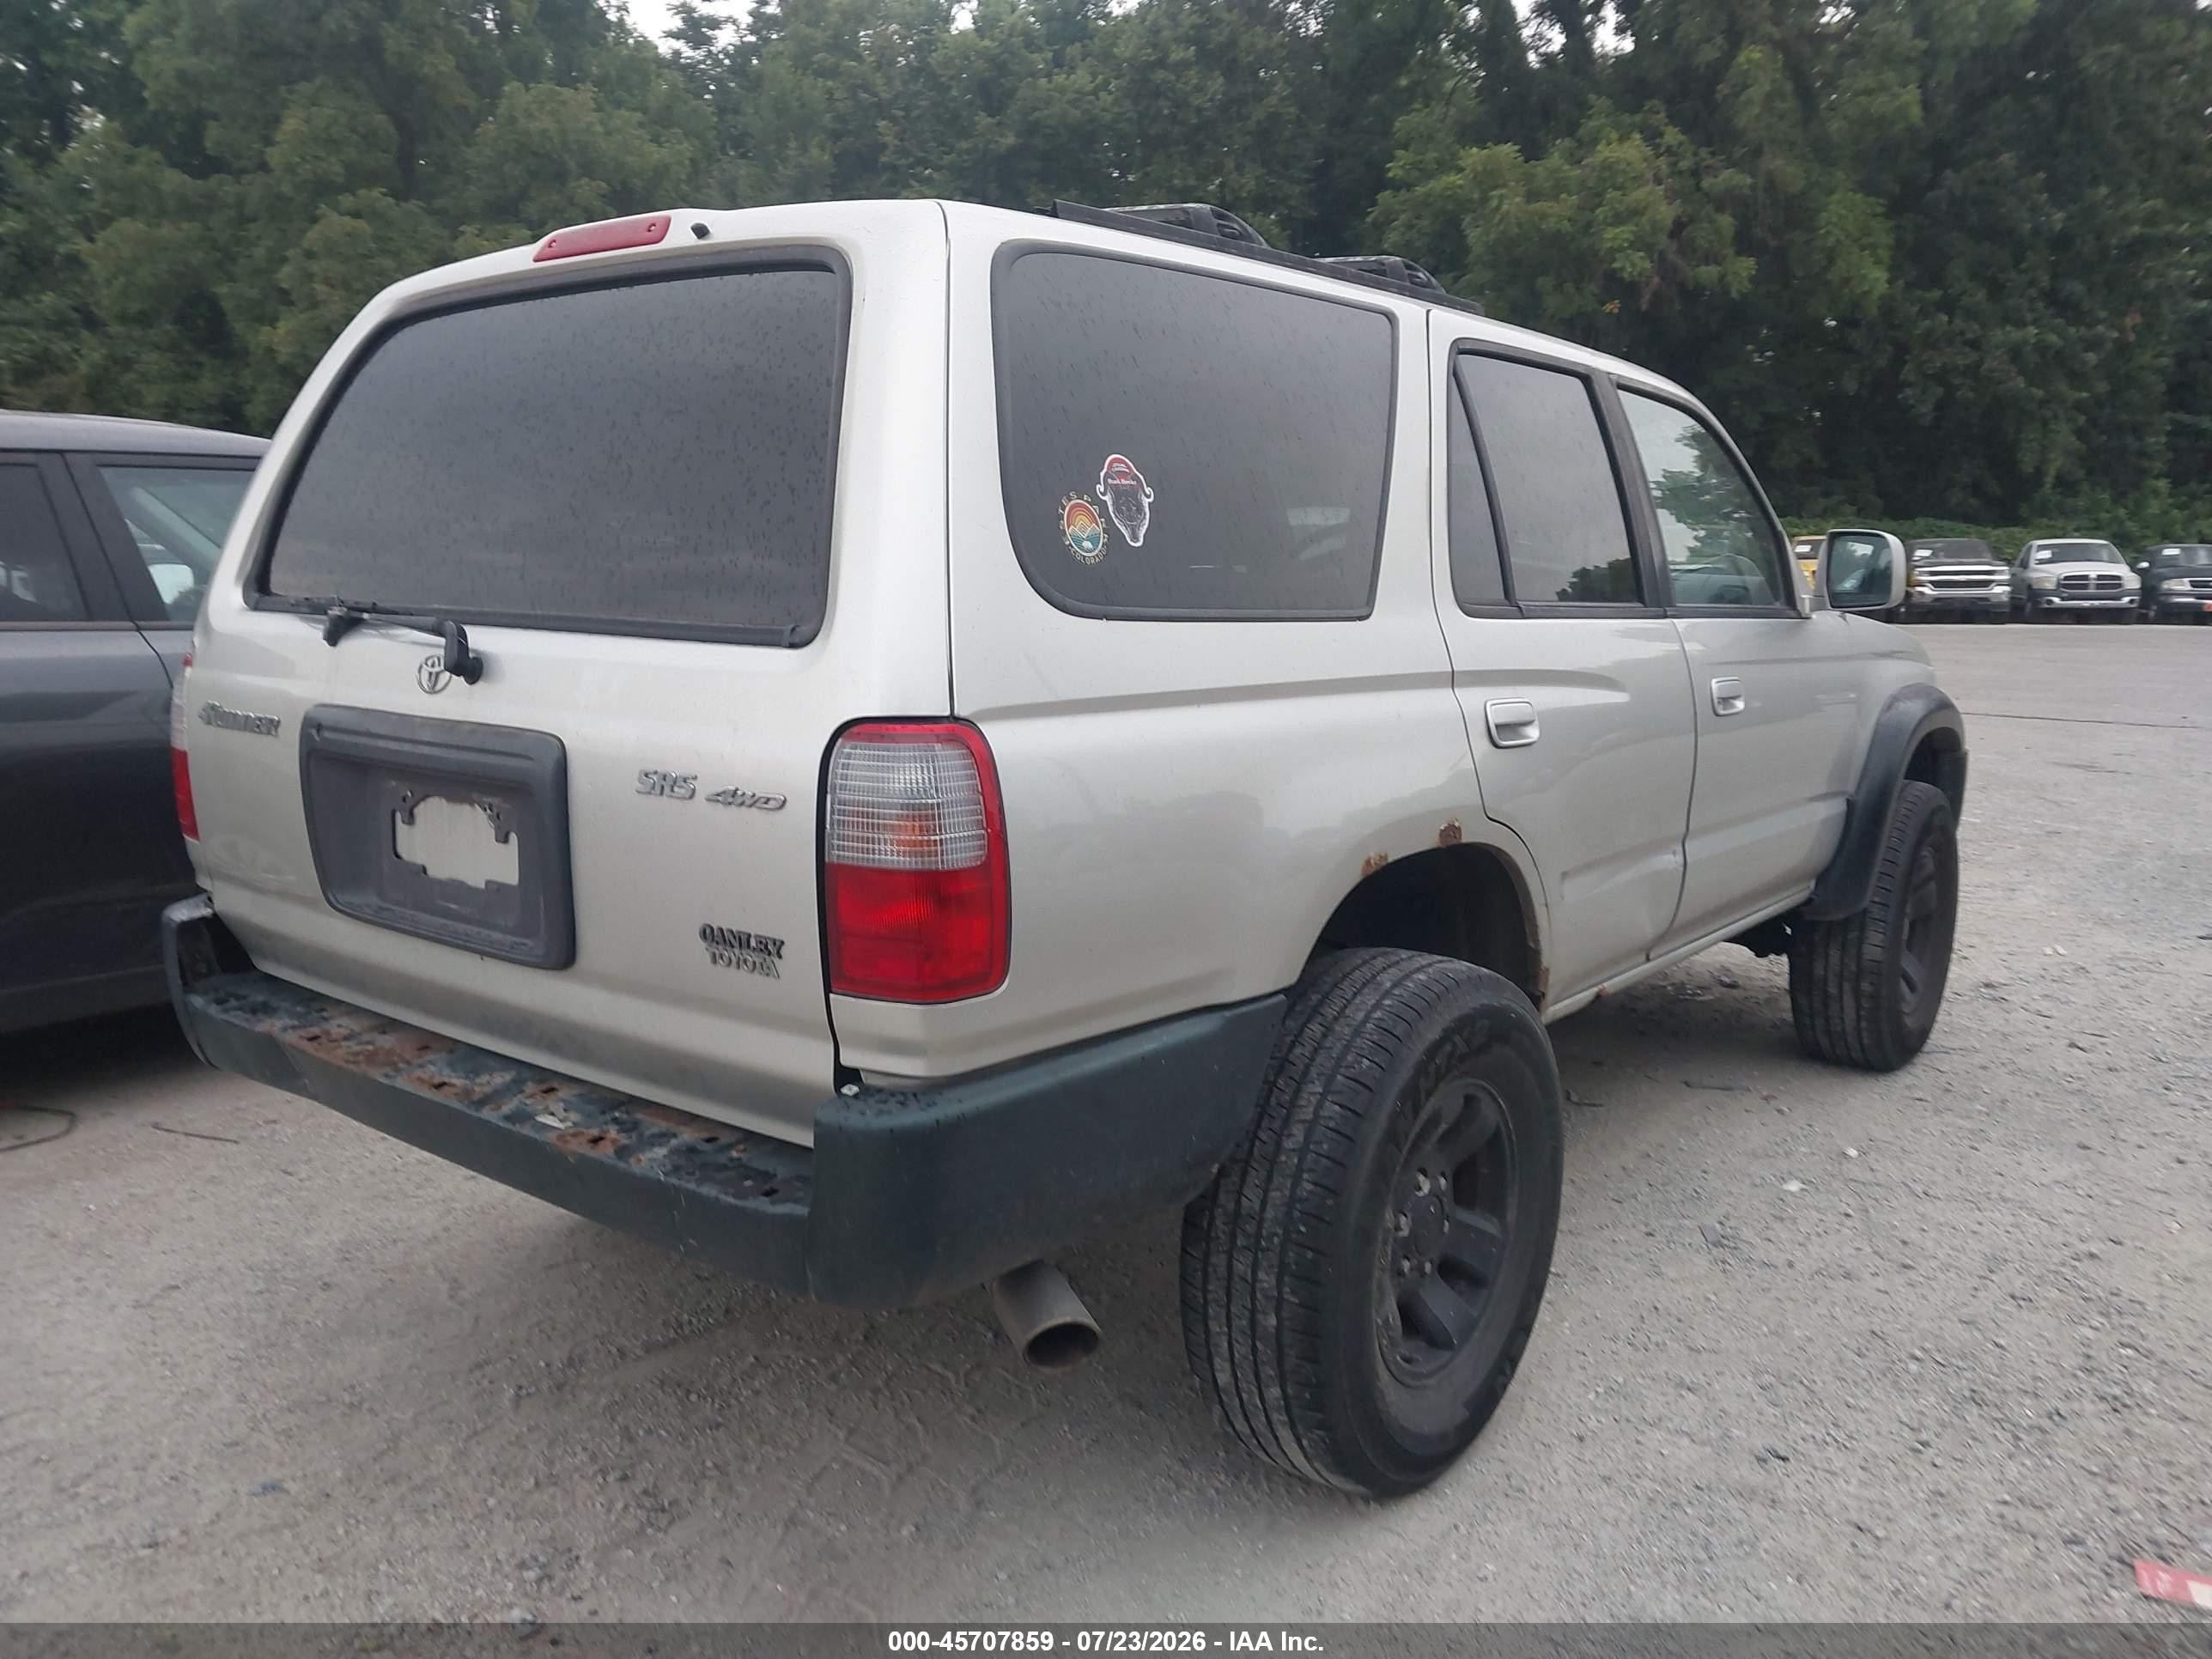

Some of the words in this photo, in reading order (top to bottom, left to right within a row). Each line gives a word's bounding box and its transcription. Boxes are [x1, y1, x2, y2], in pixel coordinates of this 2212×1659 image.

[1070, 545, 1108, 565] COLORADO
[635, 769, 698, 799] SR5
[705, 786, 787, 811] 4WD
[704, 945, 781, 980] TOYOTA
